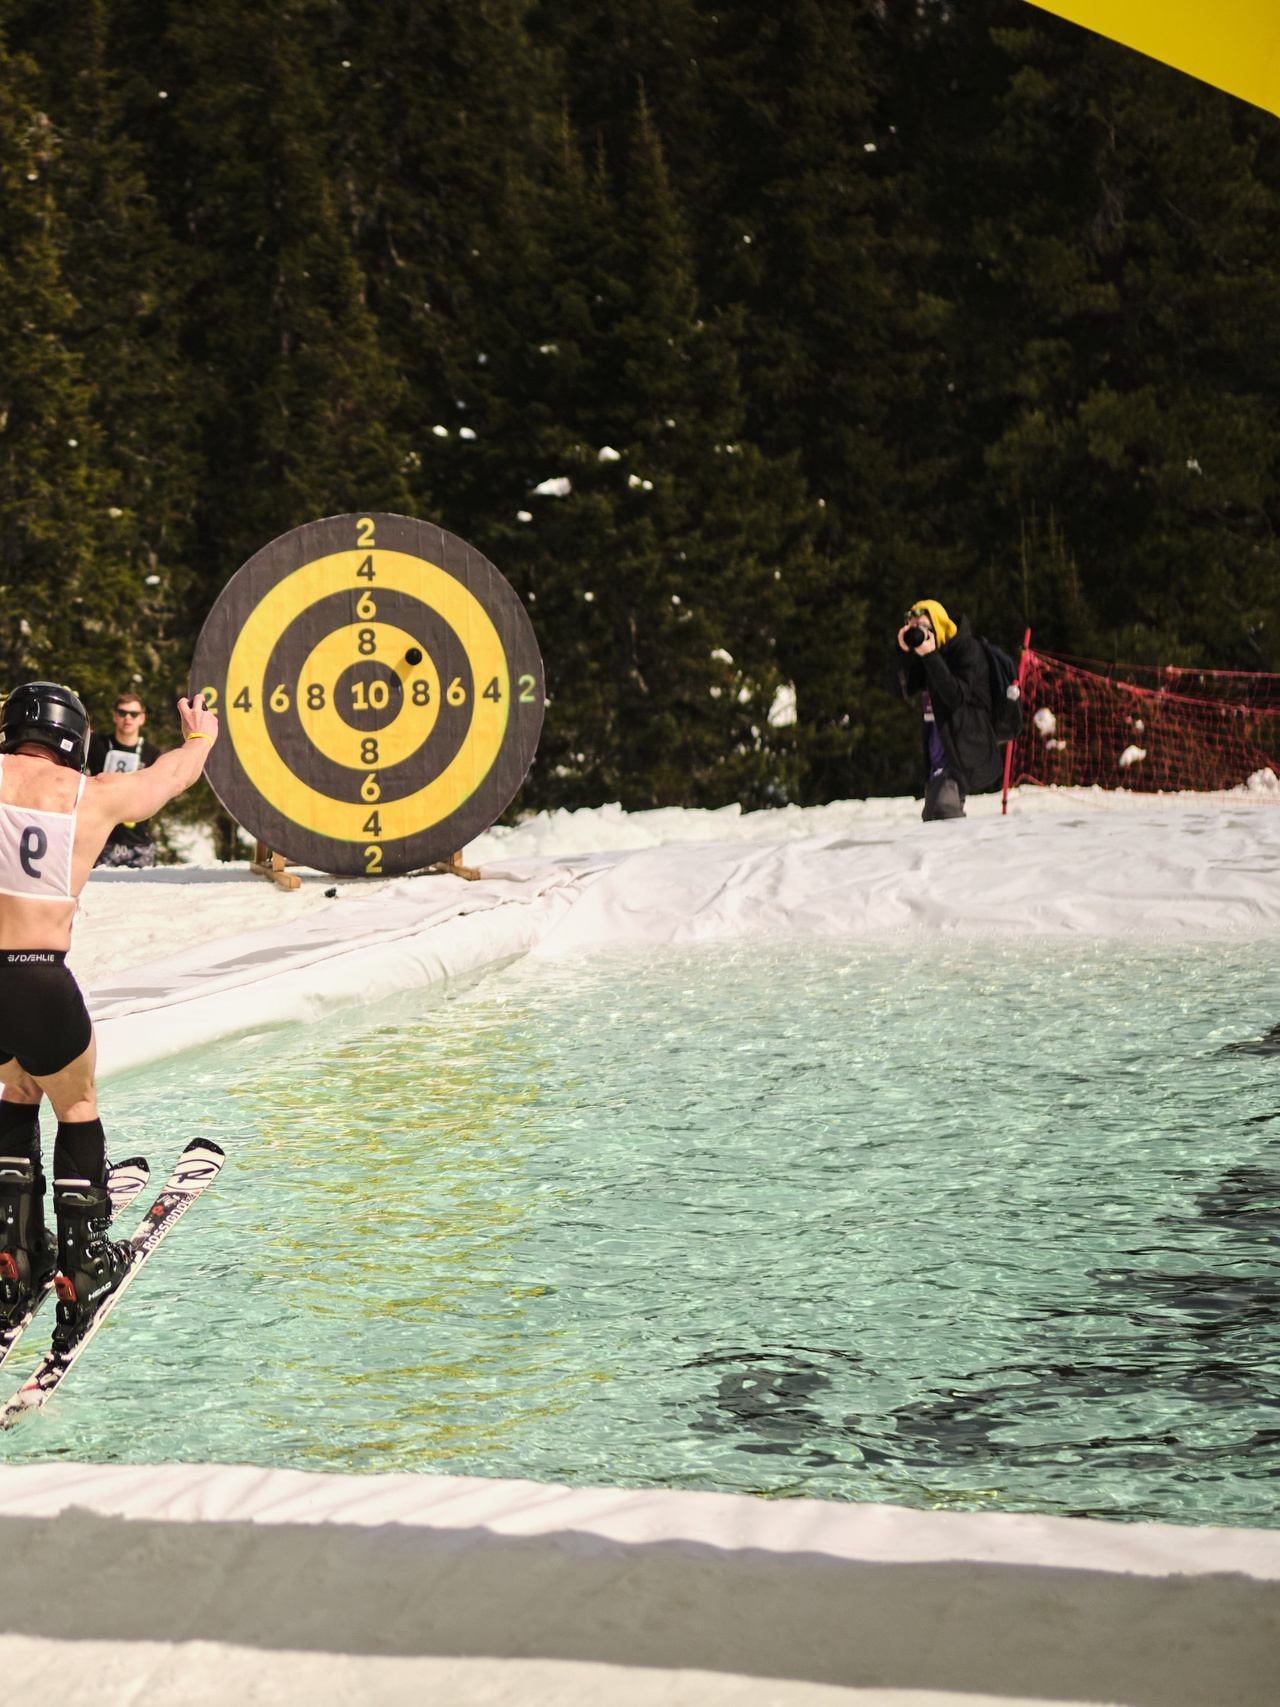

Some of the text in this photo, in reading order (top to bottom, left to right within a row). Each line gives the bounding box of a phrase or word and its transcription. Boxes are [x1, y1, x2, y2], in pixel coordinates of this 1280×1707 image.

[356, 517, 375, 547] 2
[356, 555, 375, 582] 4
[356, 591, 376, 620] 6
[358, 628, 376, 655] 8
[233, 686, 252, 713] 4
[269, 684, 289, 713] 6
[306, 683, 325, 710] 8
[351, 681, 389, 710] 10
[411, 679, 430, 706] 8
[446, 677, 466, 707] 6
[482, 676, 501, 702] 4
[518, 674, 536, 703] 2
[360, 738, 379, 764] 8
[360, 773, 381, 802] 6
[362, 811, 382, 837] 4
[363, 846, 383, 874] 2
[142, 1198, 192, 1251] ROSSIGNOL
[88, 1281, 112, 1302] HEAD
